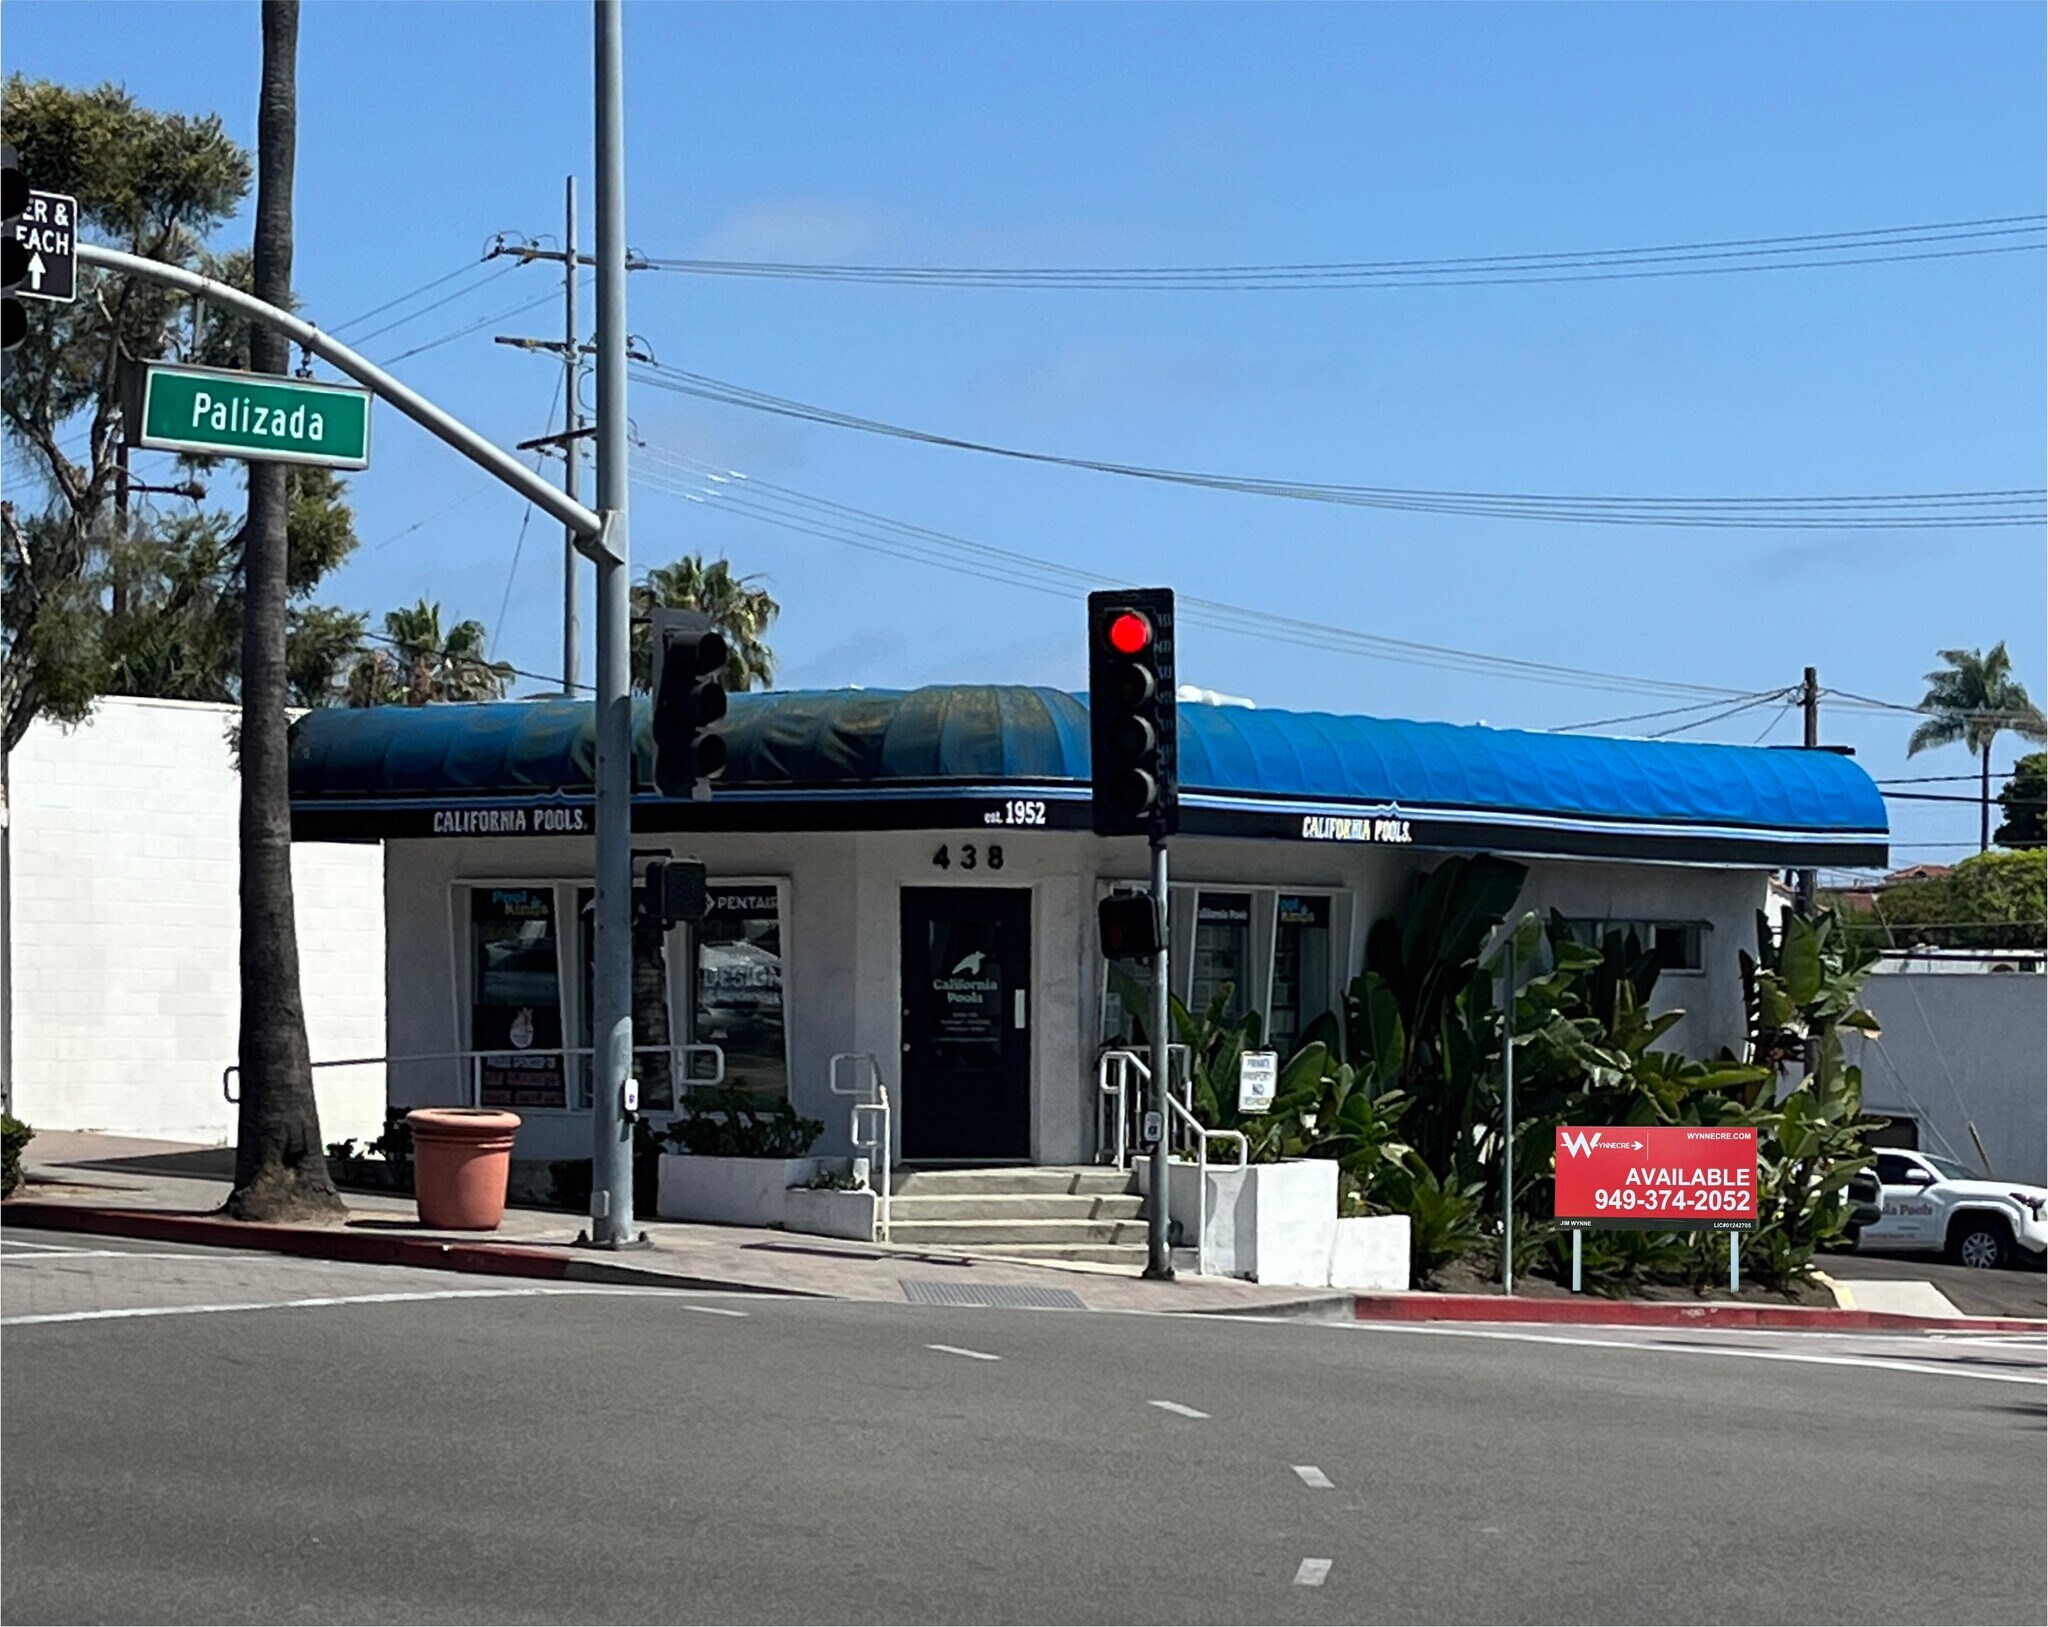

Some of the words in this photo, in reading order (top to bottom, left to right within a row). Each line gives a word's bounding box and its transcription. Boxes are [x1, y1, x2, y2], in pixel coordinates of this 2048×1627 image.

[54, 203, 69, 226] &
[192, 392, 324, 441] Palizada
[433, 809, 526, 833] CALIFORNIA
[1005, 801, 1046, 824] 1952
[1302, 816, 1371, 841] CALIFORNIA
[932, 844, 1004, 870] 438
[933, 978, 998, 991] California
[947, 991, 984, 1004] Pools
[1687, 1132, 1752, 1141] WYNNECRE.COM
[1625, 1168, 1751, 1187] AVAILABLE
[1594, 1189, 1751, 1212] 949-374-2052
